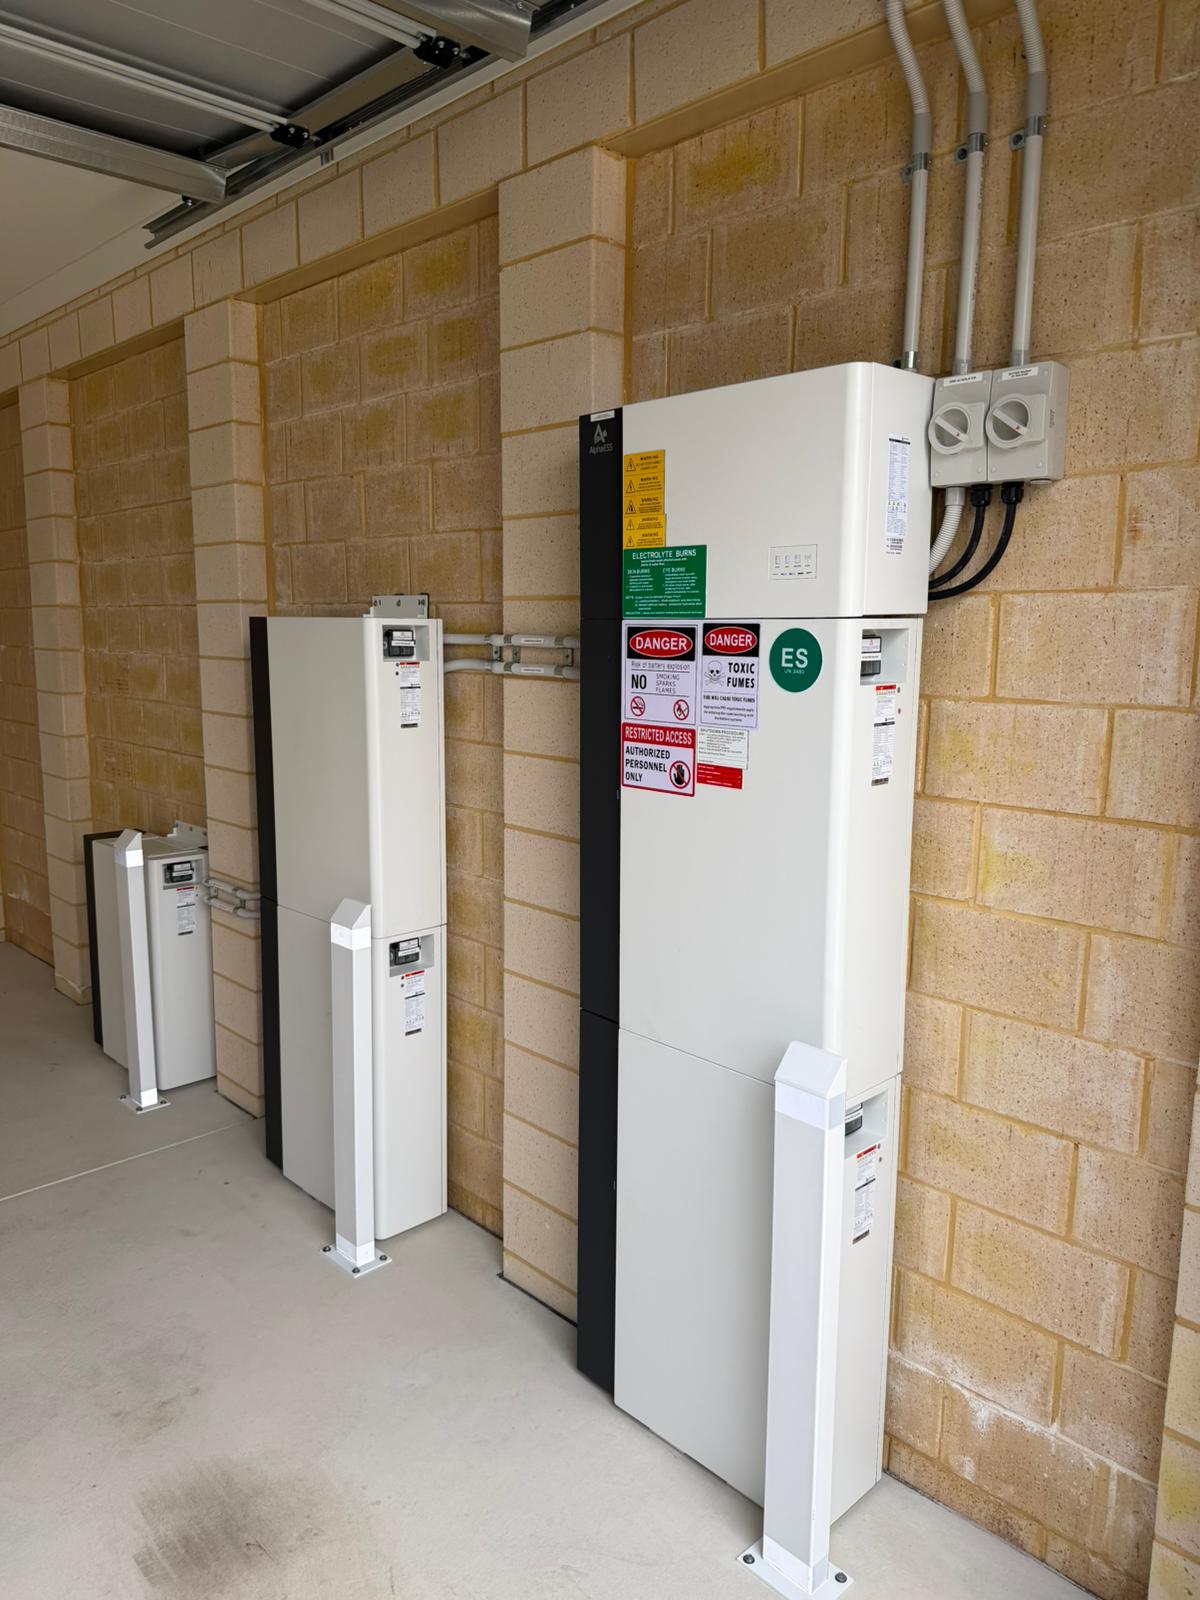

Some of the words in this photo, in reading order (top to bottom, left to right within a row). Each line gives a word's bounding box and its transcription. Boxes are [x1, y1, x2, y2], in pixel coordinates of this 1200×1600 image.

[632, 551, 673, 560] ELECTROLYTE
[675, 549, 697, 558] BURNS
[635, 637, 687, 651] DANGER
[709, 633, 753, 647] DANGER
[781, 647, 808, 669] ES
[631, 660, 640, 668] Risk
[667, 663, 690, 671] explosion
[728, 662, 755, 674] TOXIC
[631, 674, 647, 690] NO
[656, 673, 680, 681] SMOKING
[727, 677, 755, 688] FUMES
[625, 726, 664, 742] RESTRICTED
[665, 730, 693, 745] ACCESS
[625, 746, 671, 760] AUTHORIZED
[625, 758, 667, 772] PERSONNEL
[625, 771, 643, 782] ONLY
